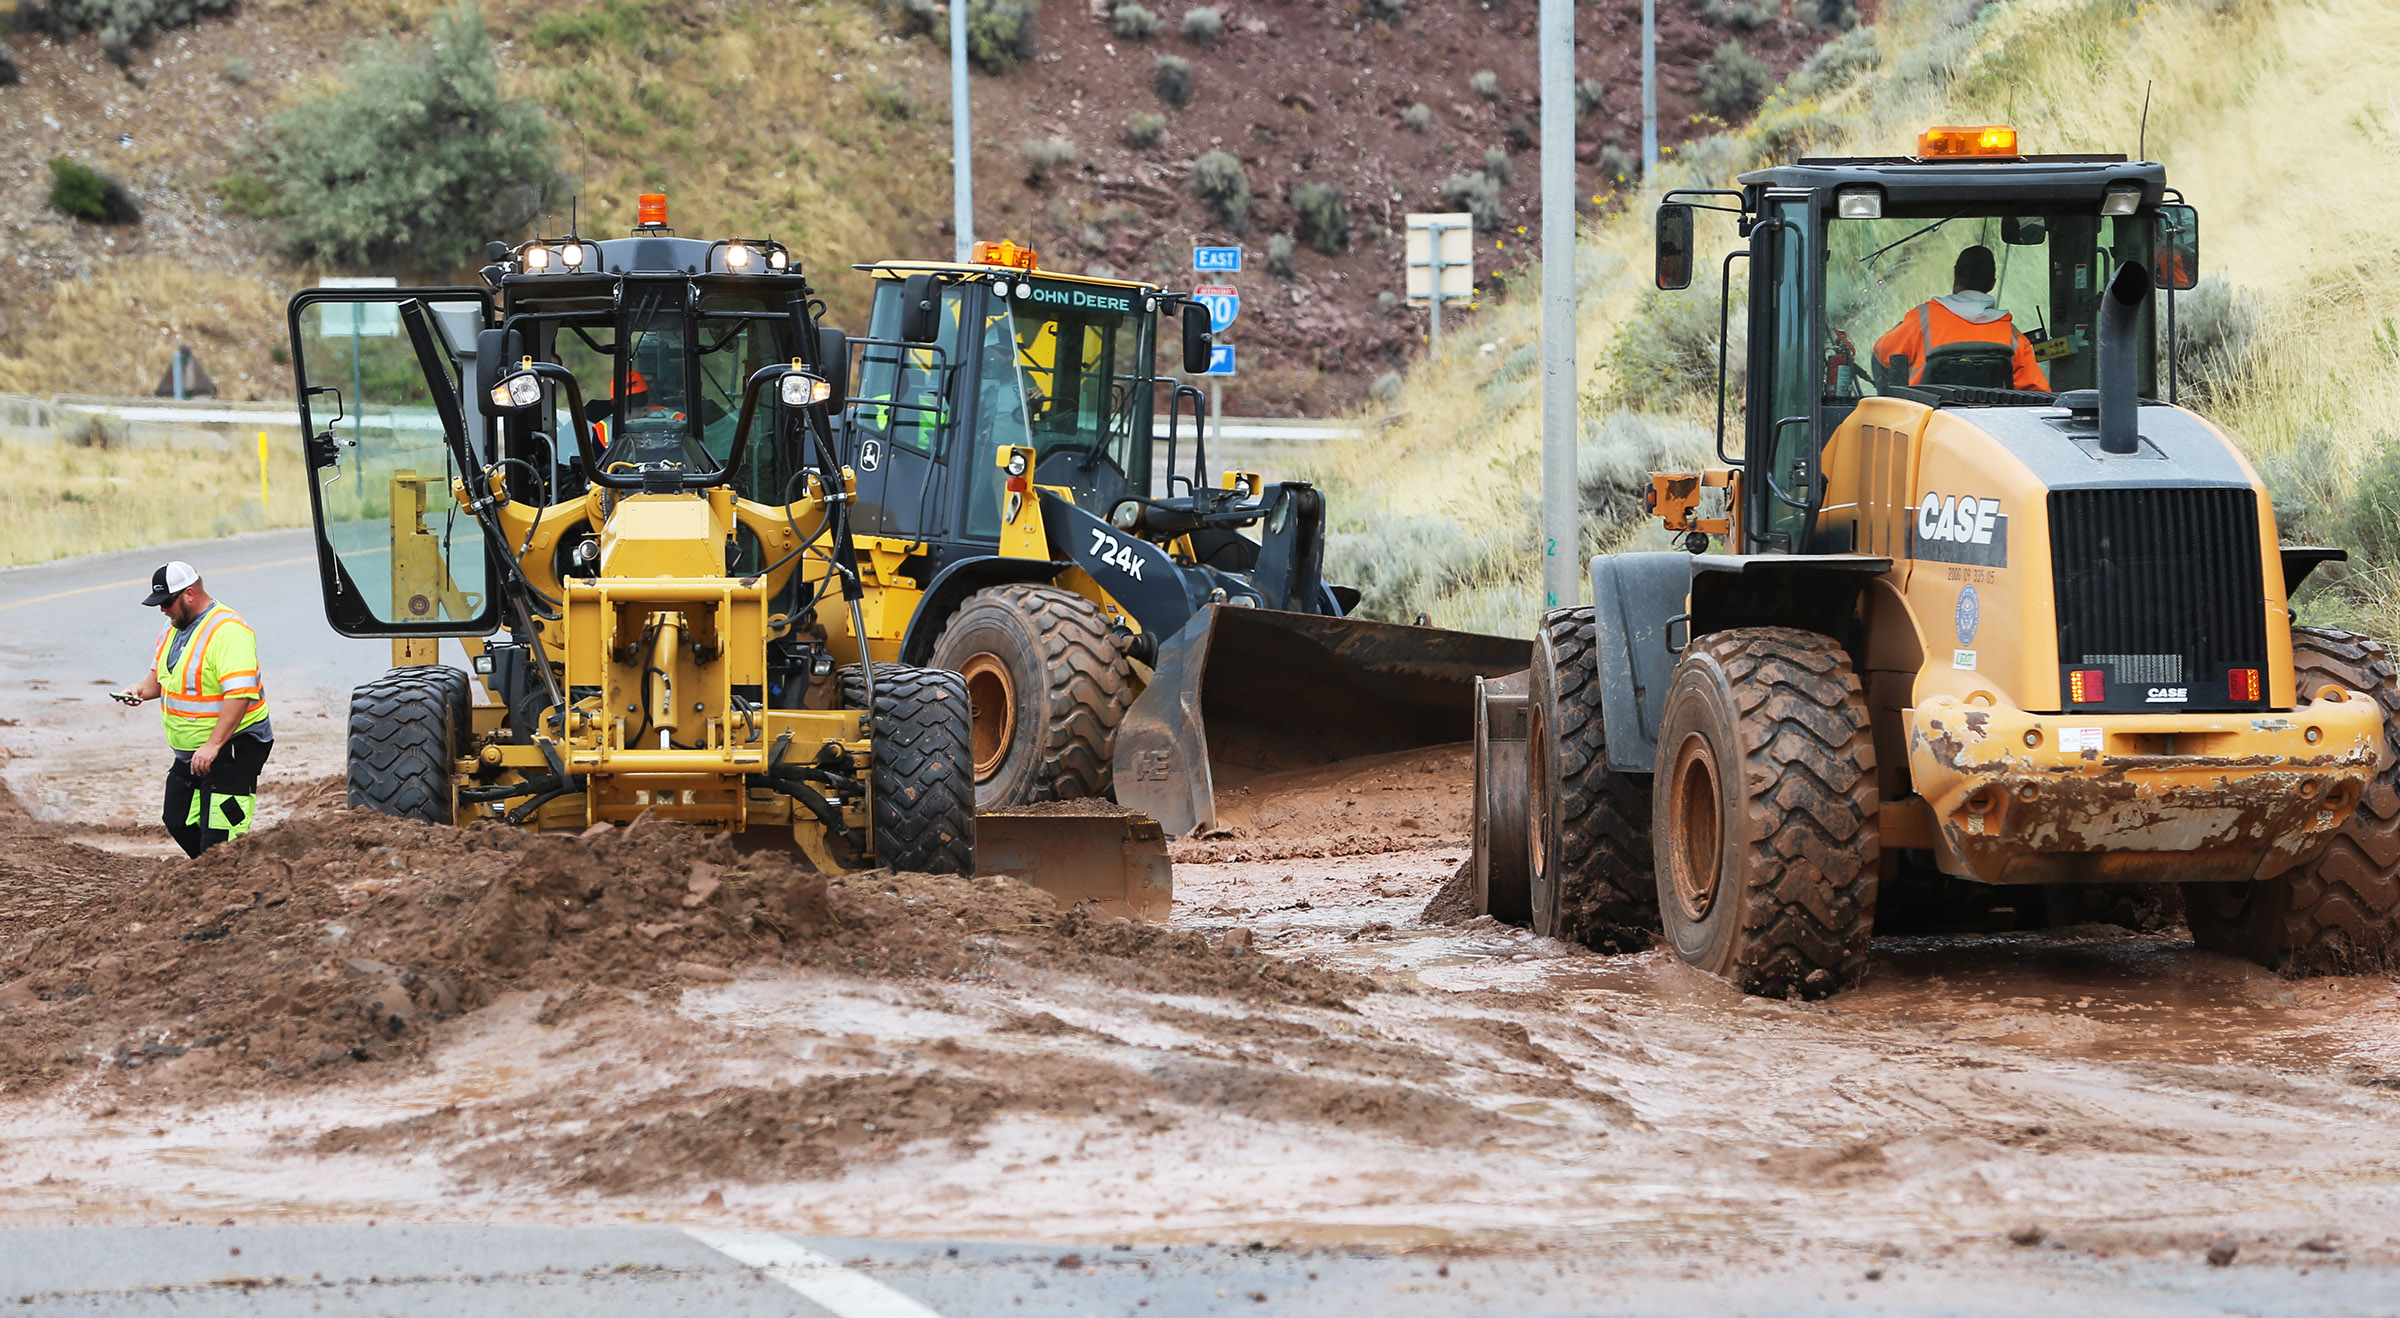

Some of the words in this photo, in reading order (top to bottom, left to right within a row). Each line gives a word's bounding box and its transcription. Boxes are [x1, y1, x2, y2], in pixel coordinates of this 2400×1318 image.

[1199, 250, 1235, 267] EAST
[1029, 288, 1069, 305] OHN
[1073, 290, 1130, 311] DEERE
[1918, 491, 2001, 545] CASE
[1089, 527, 1146, 582] 724K
[1547, 538, 1557, 556] 2
[2147, 688, 2188, 698] CASE
